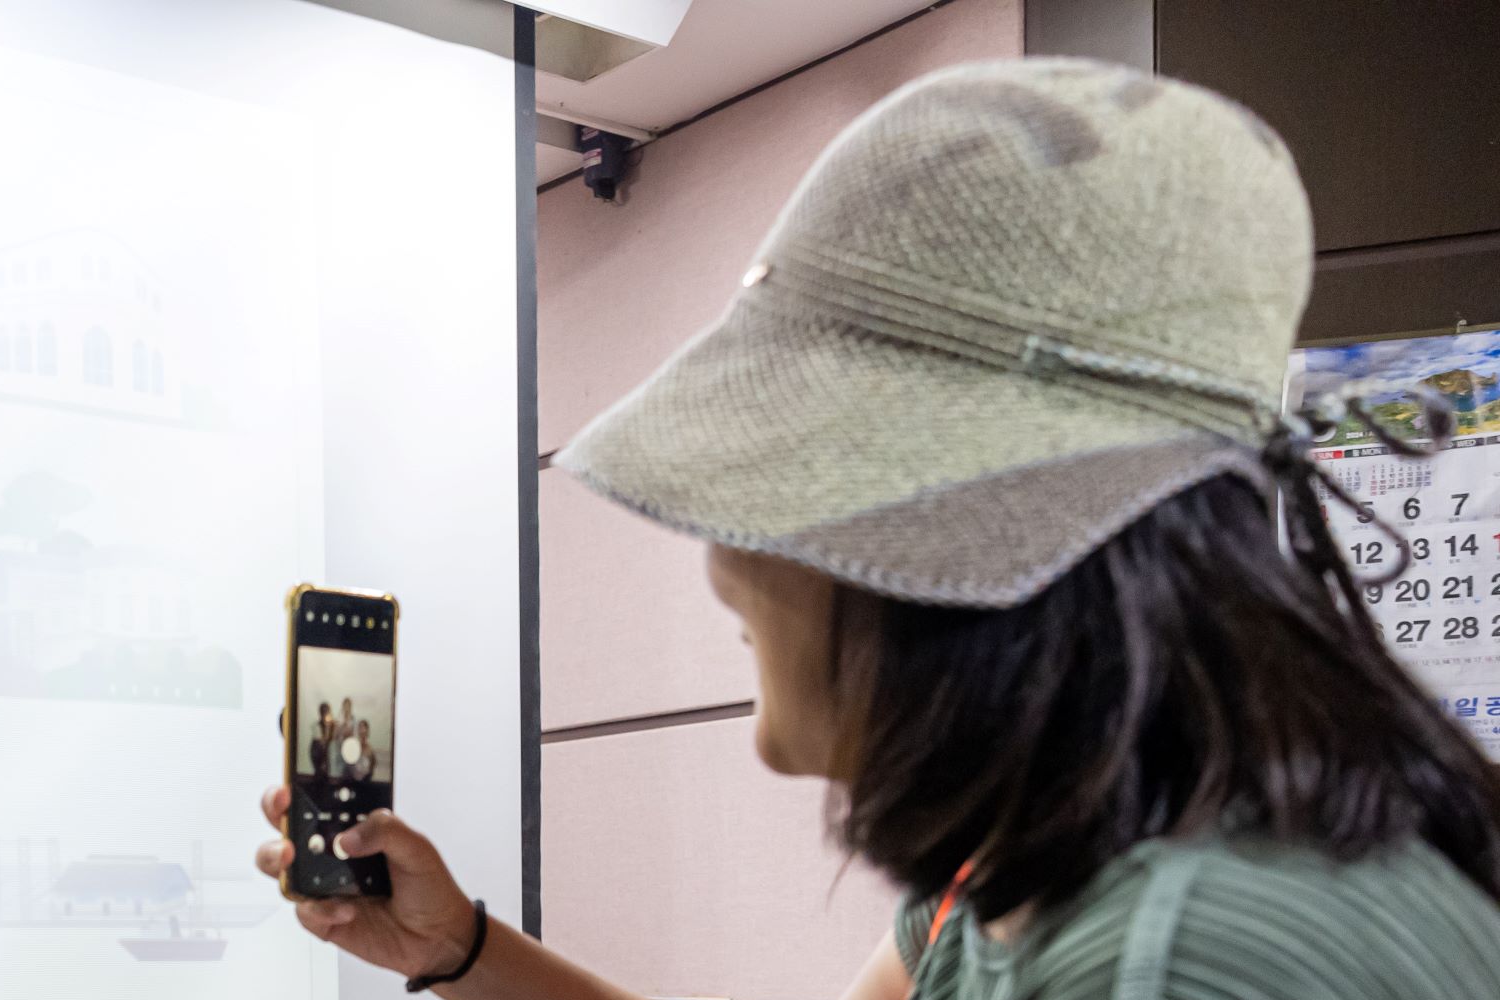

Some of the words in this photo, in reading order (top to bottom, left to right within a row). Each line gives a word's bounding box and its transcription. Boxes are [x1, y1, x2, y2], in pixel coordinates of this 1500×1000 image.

[1403, 497, 1421, 520] 6
[1451, 493, 1470, 516] 7
[1350, 541, 1383, 564] 12
[1444, 534, 1479, 557] 14
[1395, 579, 1430, 602] 20
[1442, 575, 1474, 599] 21
[1396, 620, 1431, 643] 27
[1443, 616, 1479, 640] 28
